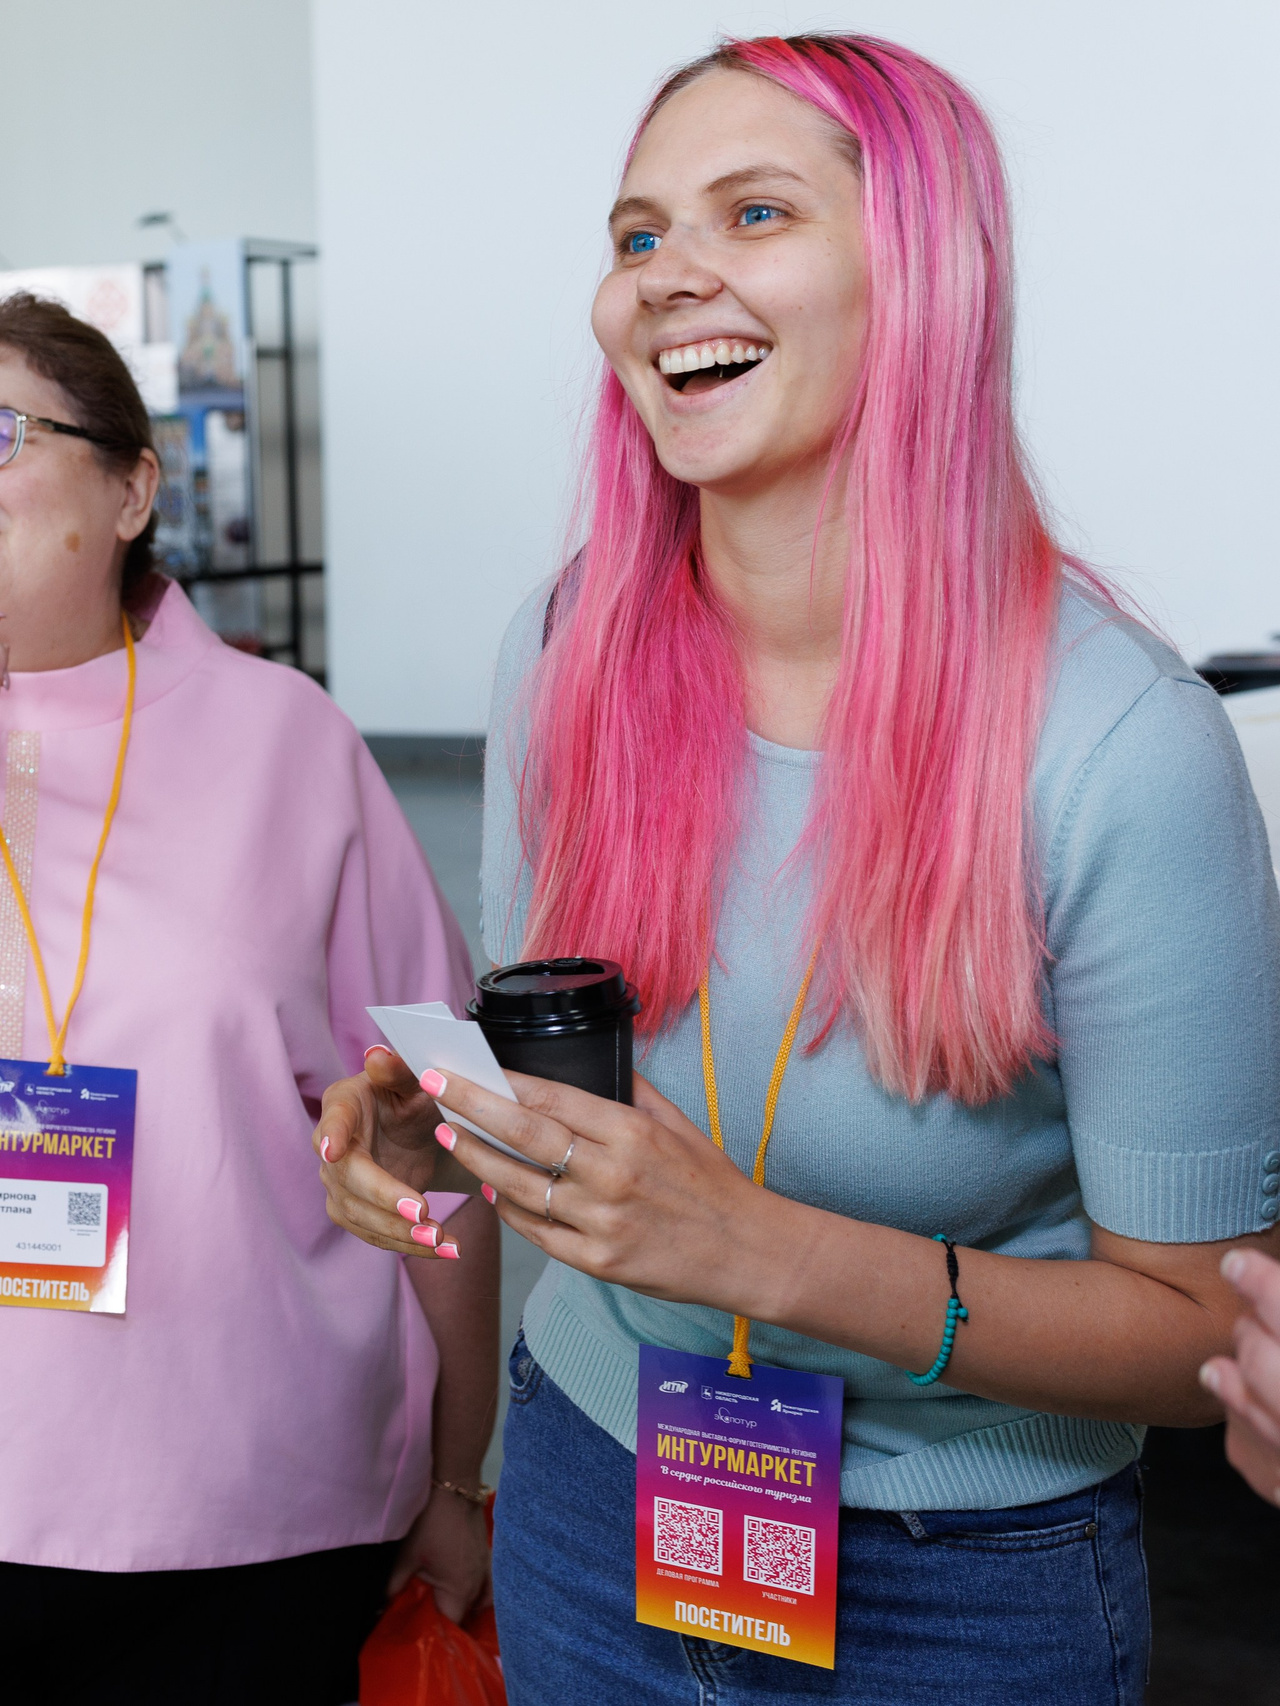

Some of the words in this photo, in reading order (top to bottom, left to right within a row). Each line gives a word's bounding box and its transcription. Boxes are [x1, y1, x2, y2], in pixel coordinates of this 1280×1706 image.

[15, 1242, 62, 1252] 431445001
[657, 1423, 700, 1437] МЕЖДУНАРОДНАЯ
[701, 1431, 746, 1446] ВЫСТАВКА-ФОРУМ
[746, 1440, 790, 1454] ГОСТЕПРИИМСТВА
[791, 1448, 817, 1459] РЕГИОНОВ
[657, 1433, 817, 1487] ИНТУРМАРКЕТ
[660, 1465, 669, 1475] В
[670, 1469, 702, 1482] сердце
[703, 1476, 763, 1494] российского
[765, 1488, 812, 1503] туризма
[656, 1568, 683, 1580] ДЕЛОВАЯ
[684, 1573, 720, 1588] ПРОГРАММА
[761, 1591, 797, 1605] УЧАСТНИКИ
[675, 1600, 791, 1647] ПОСЕТИТЕЛЬ
